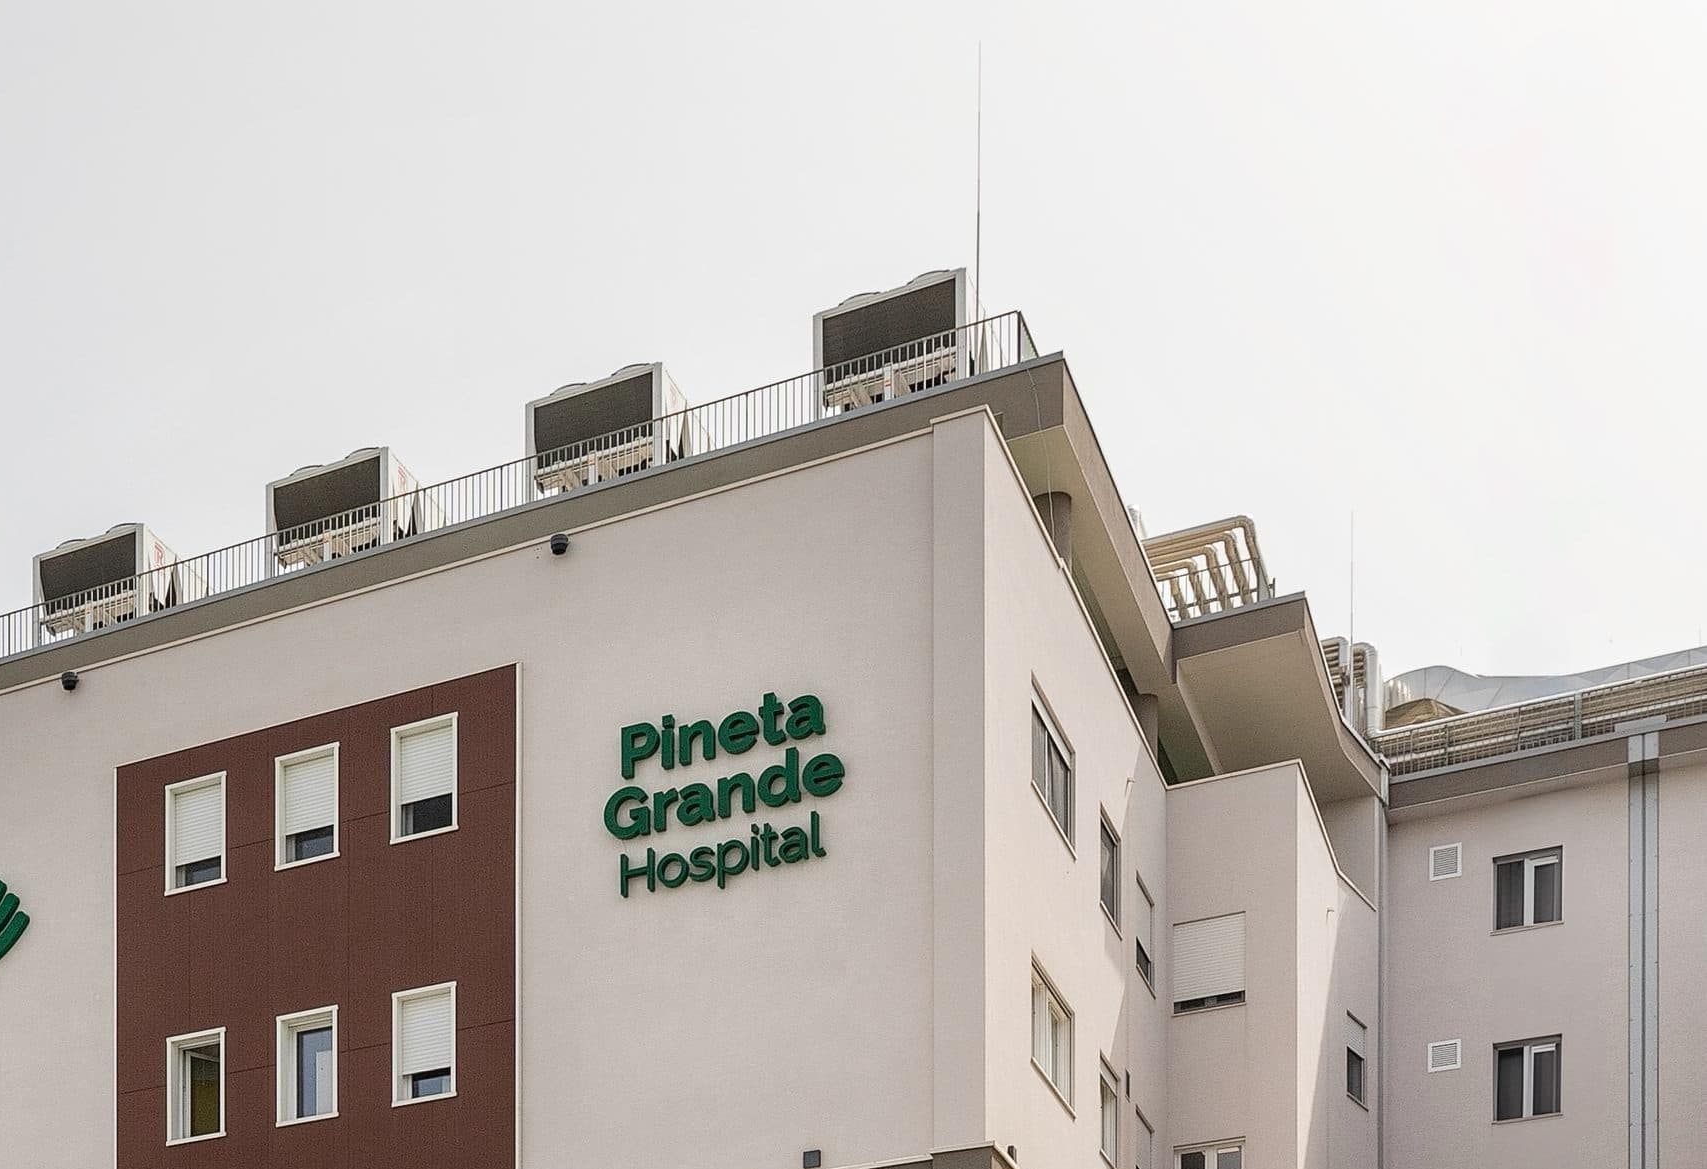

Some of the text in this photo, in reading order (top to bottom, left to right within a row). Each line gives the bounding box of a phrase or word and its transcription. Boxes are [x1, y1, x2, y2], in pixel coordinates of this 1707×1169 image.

[621, 692, 826, 780] Pineta
[603, 747, 846, 840] Grande
[620, 811, 827, 898] Hospital
